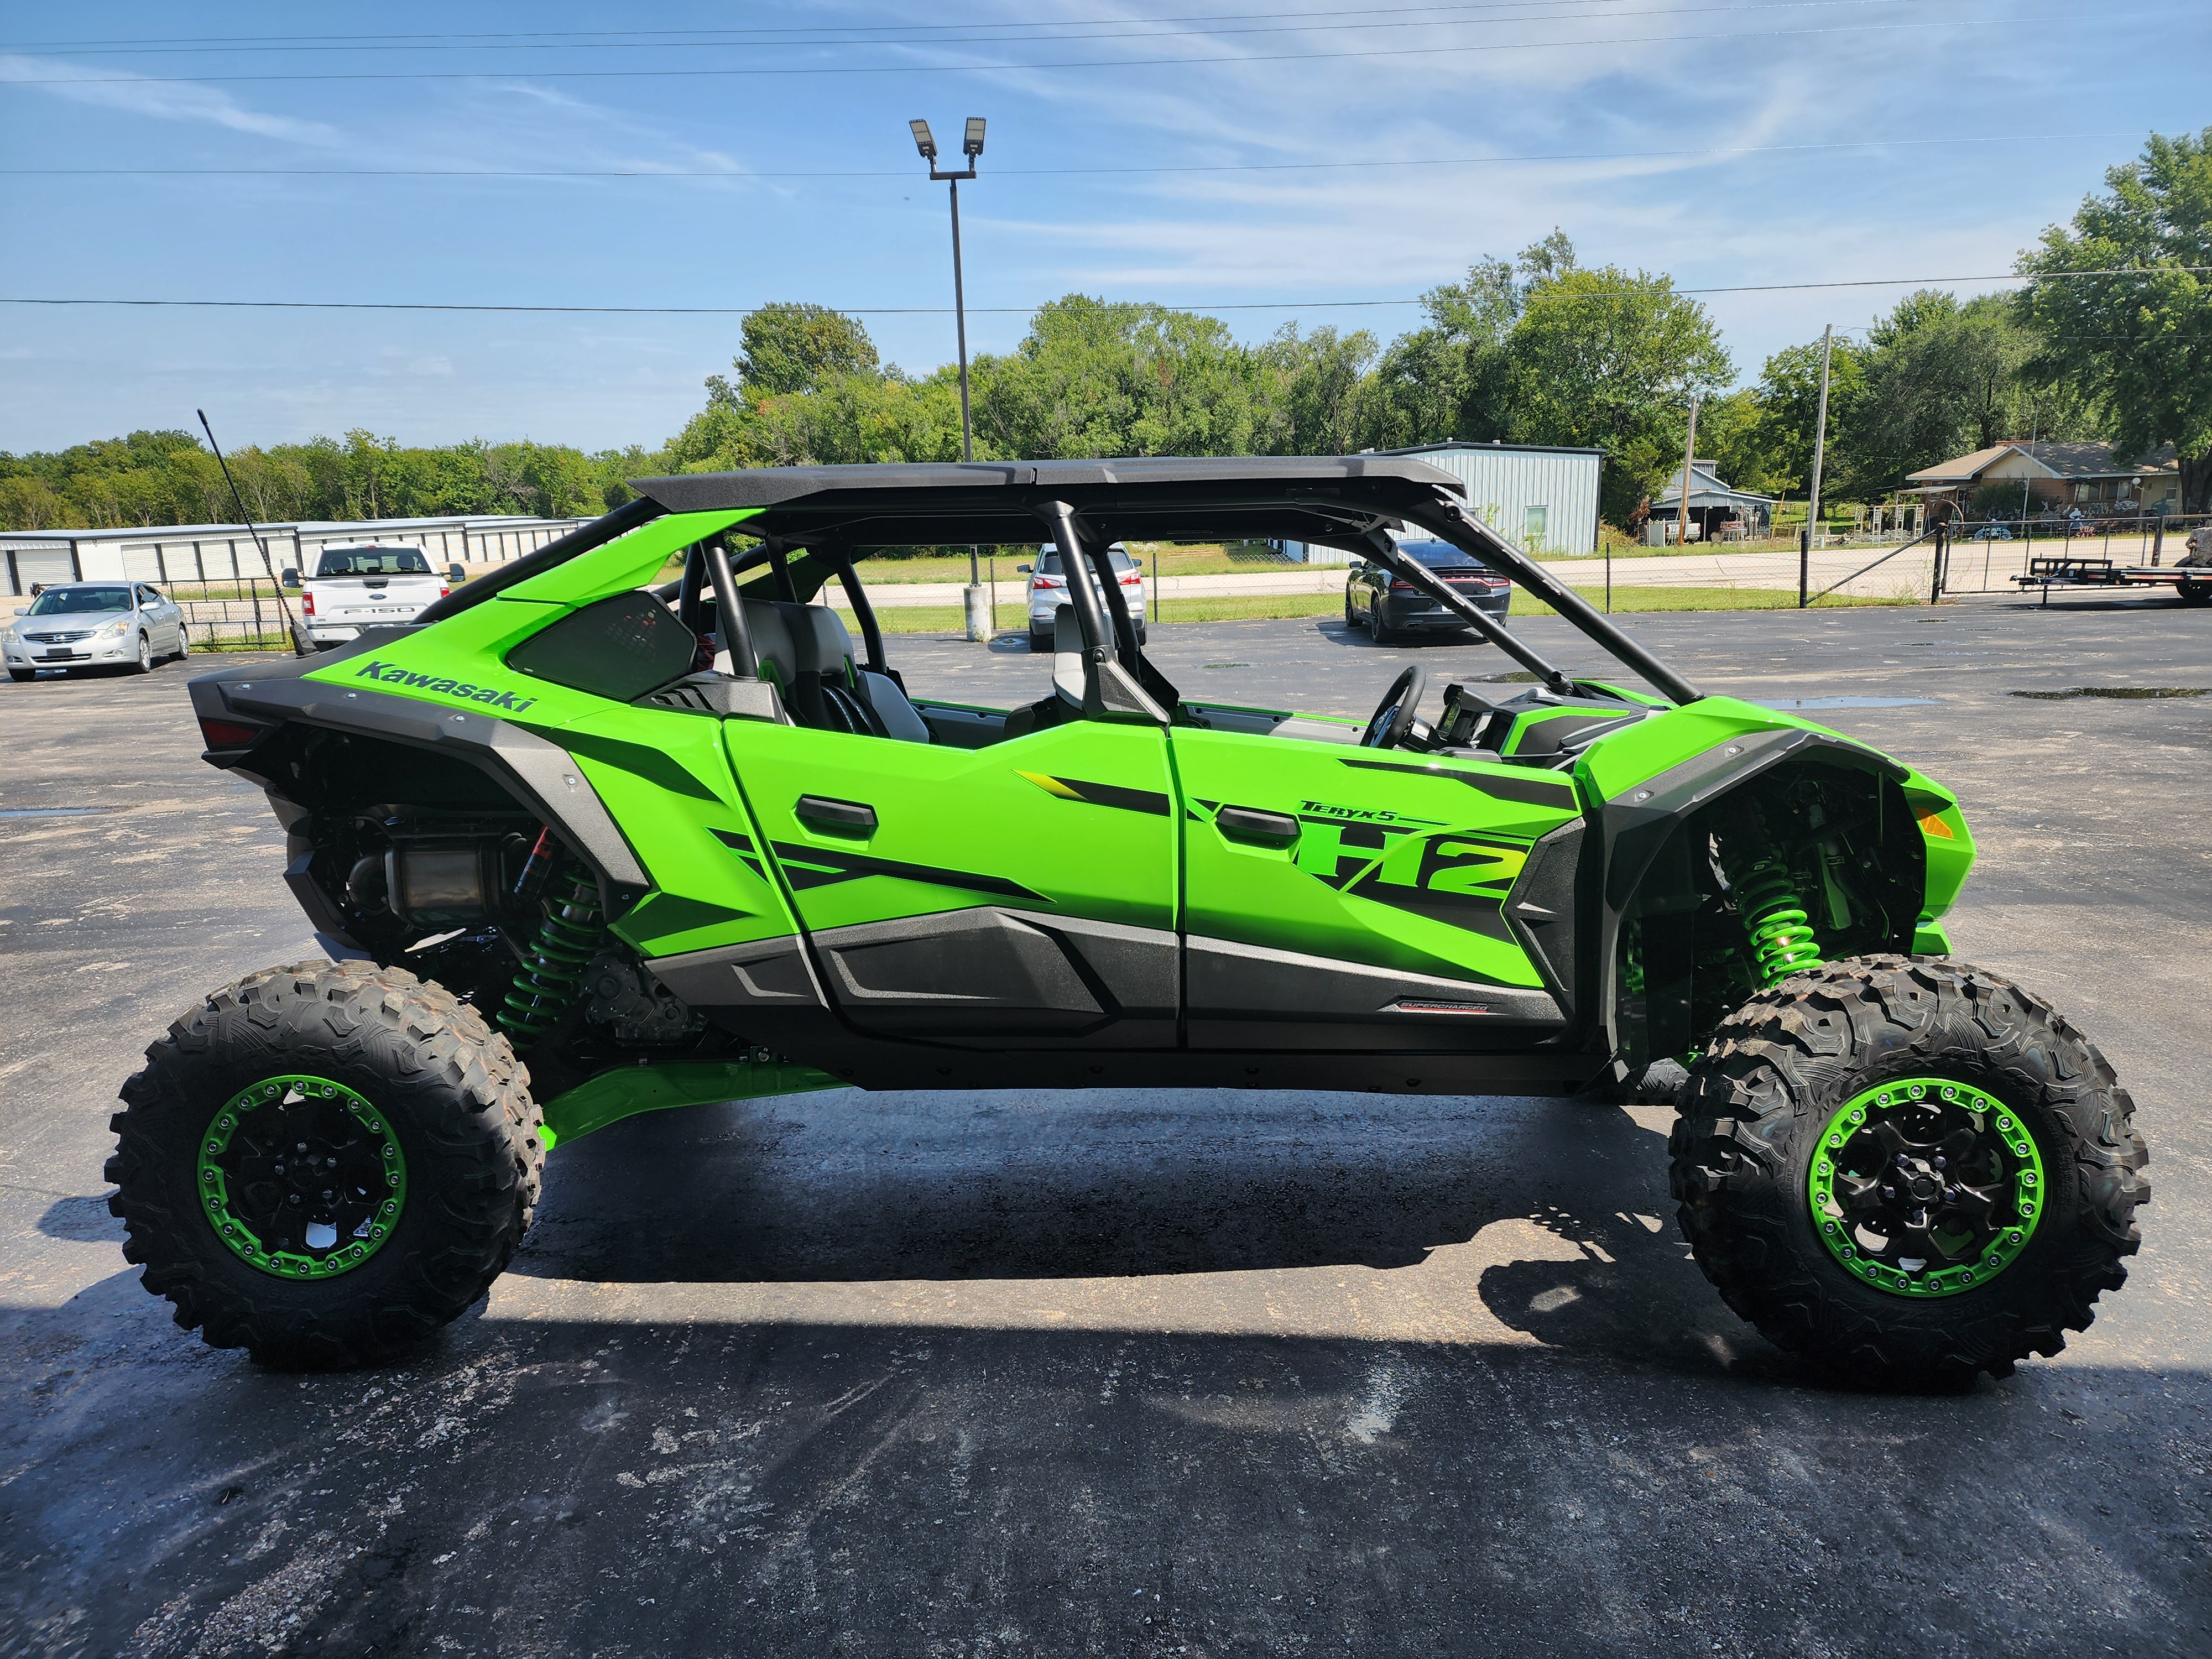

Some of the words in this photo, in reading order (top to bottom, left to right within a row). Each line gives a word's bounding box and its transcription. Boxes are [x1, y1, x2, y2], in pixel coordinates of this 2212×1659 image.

[355, 661, 538, 713] Kawasaki
[1297, 822, 1527, 899] H2
[1400, 1002, 1488, 1011] SUPERCHARGED
